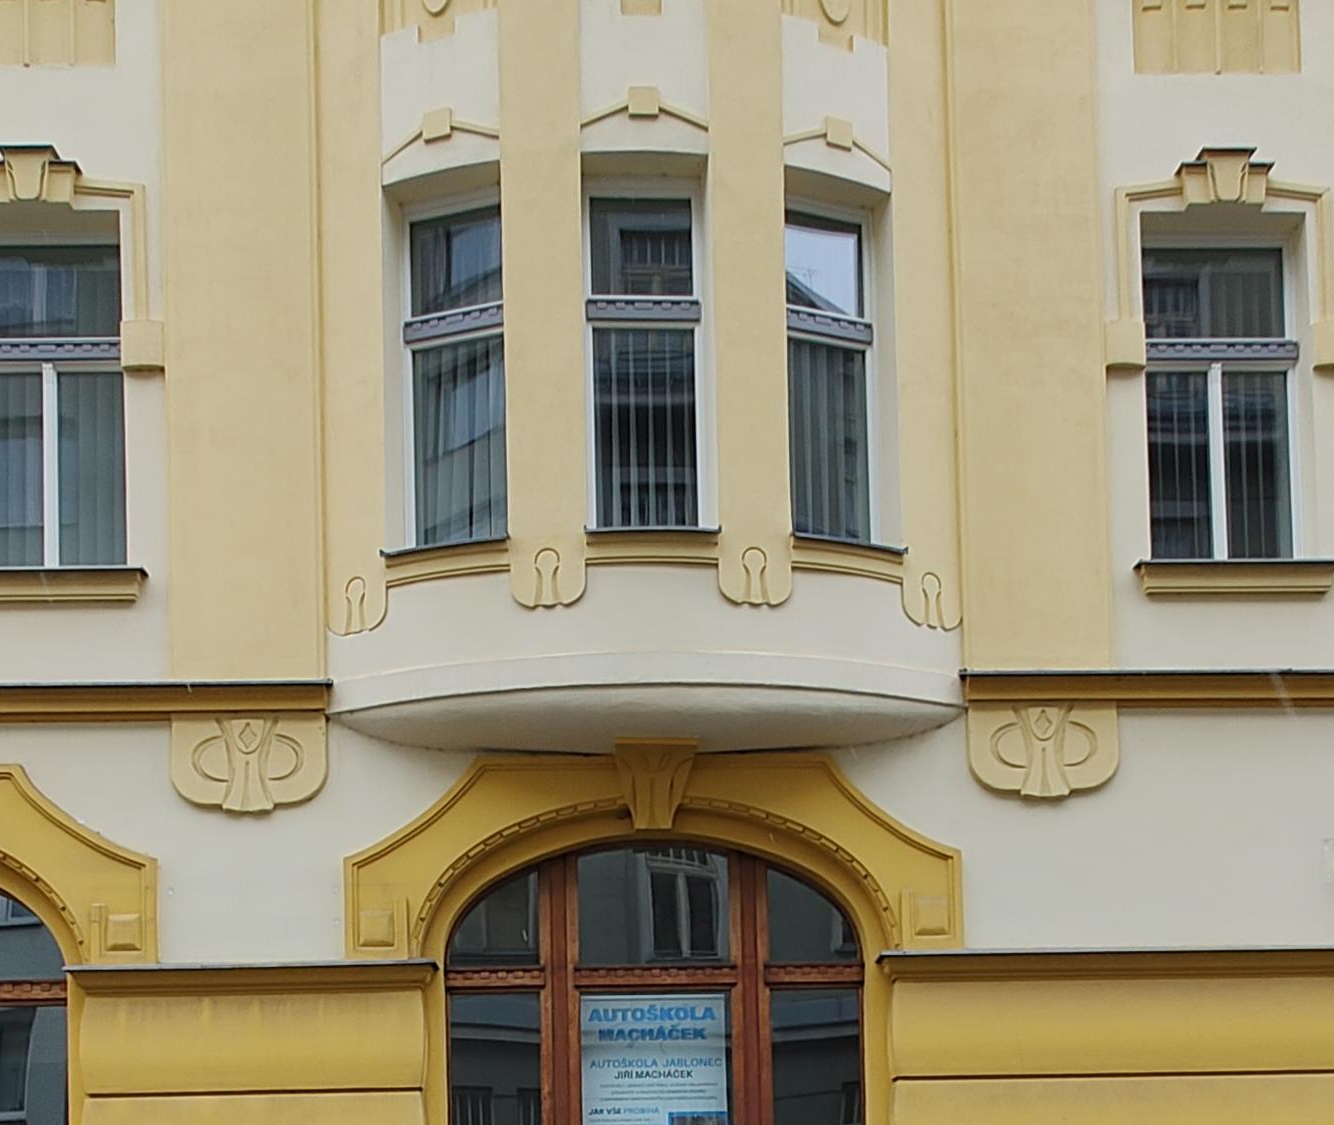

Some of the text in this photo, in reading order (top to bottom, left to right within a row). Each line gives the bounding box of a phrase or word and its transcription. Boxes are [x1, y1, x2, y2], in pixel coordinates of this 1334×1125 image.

[588, 1004, 716, 1022] AUTOŠKOLA
[598, 1023, 707, 1041] MACHÁČEK
[589, 1057, 723, 1069] AUTOŠKOLA JABLONEC
[614, 1069, 693, 1080] JIŘÍ MACHÁČEK
